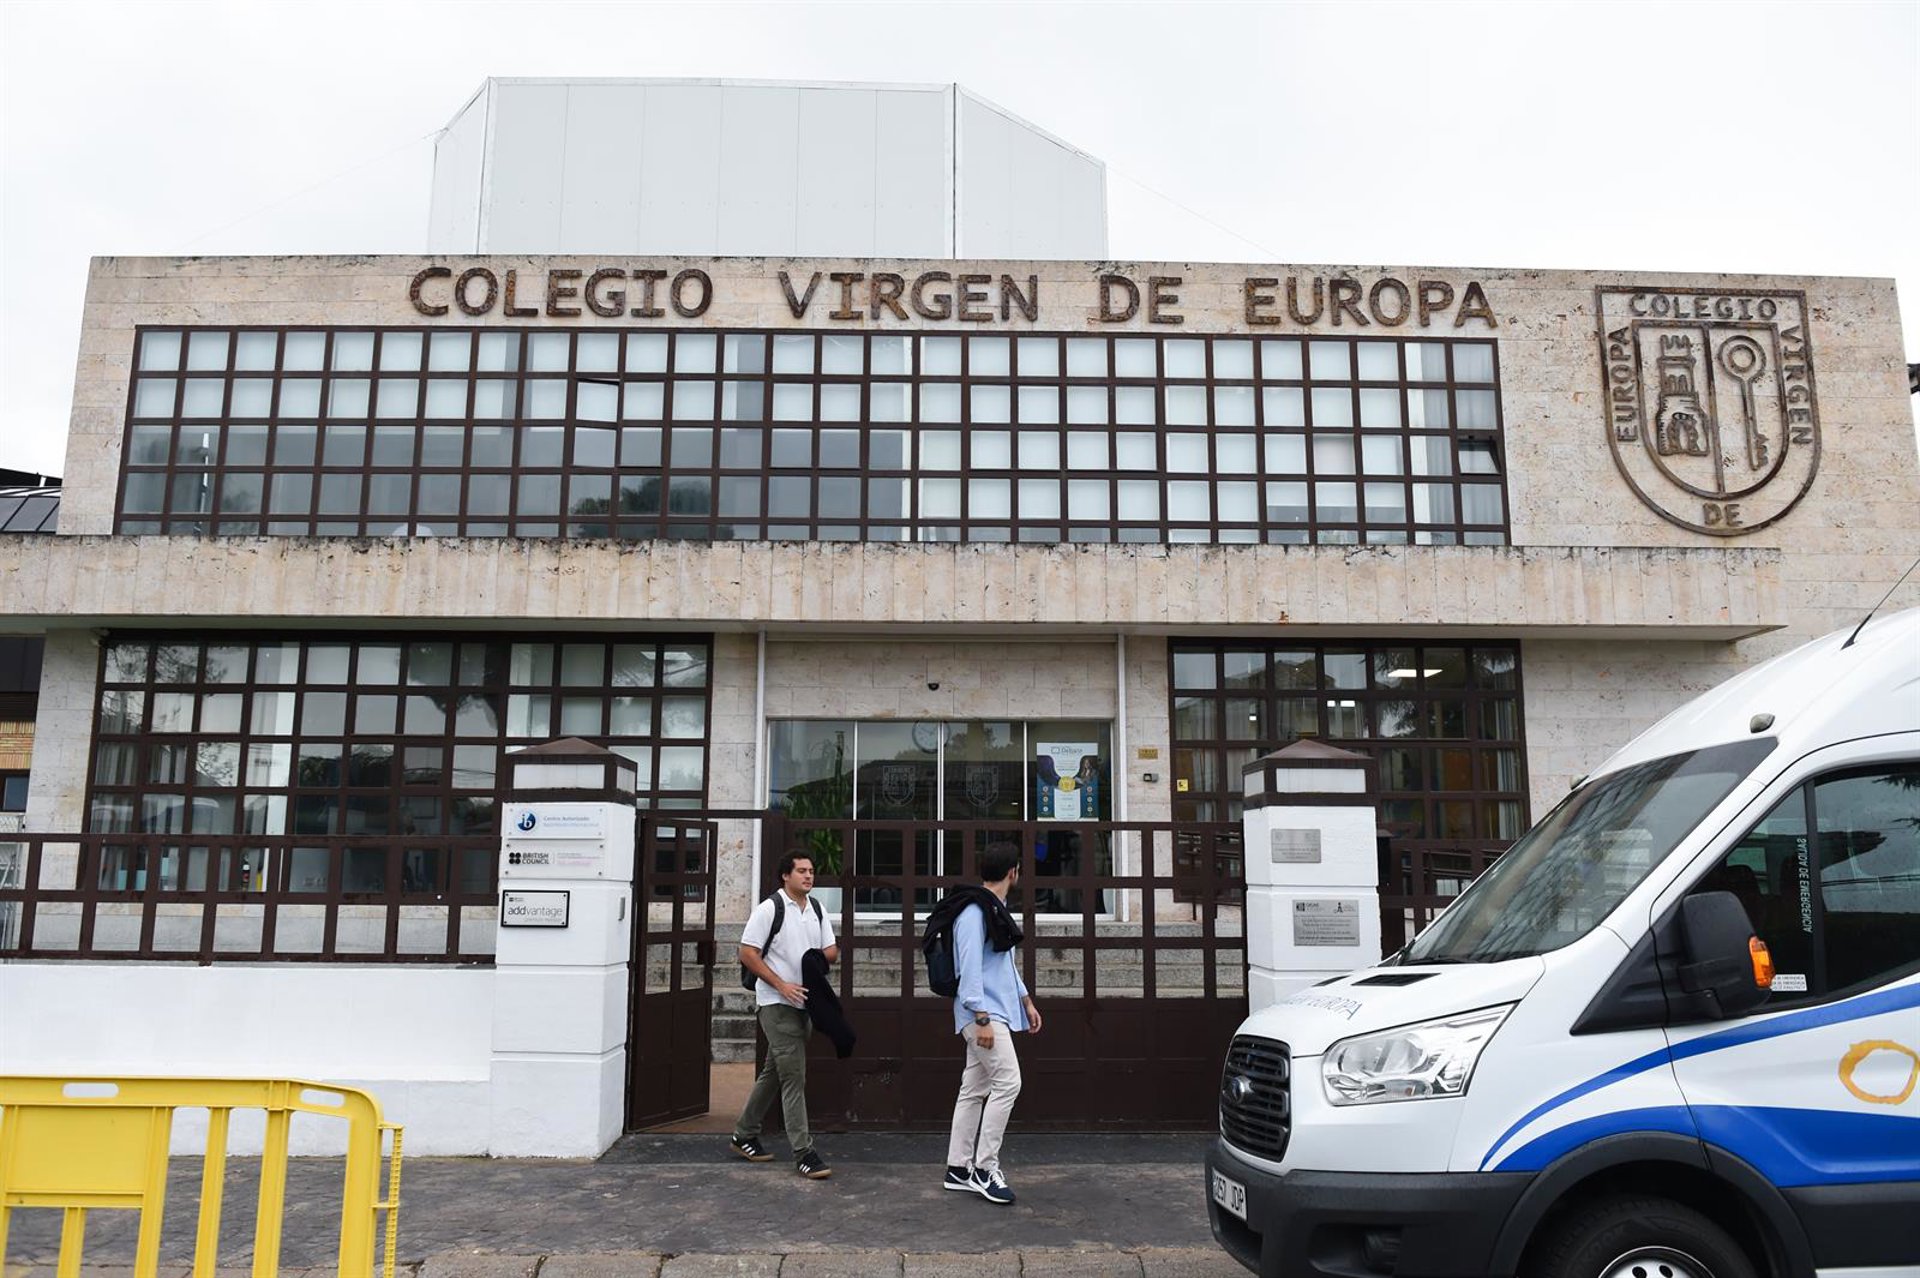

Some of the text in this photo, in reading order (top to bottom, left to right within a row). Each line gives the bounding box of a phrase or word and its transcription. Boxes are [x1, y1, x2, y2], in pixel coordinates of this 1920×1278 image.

[408, 266, 1498, 329] COLEGIO VIRGEN DE EUROPA
[1629, 293, 1777, 320] COLEGIO
[1608, 326, 1639, 442] EUROPA
[1781, 325, 1814, 445] VIRGEN
[1702, 502, 1744, 527] DE
[508, 905, 563, 917] addvantage
